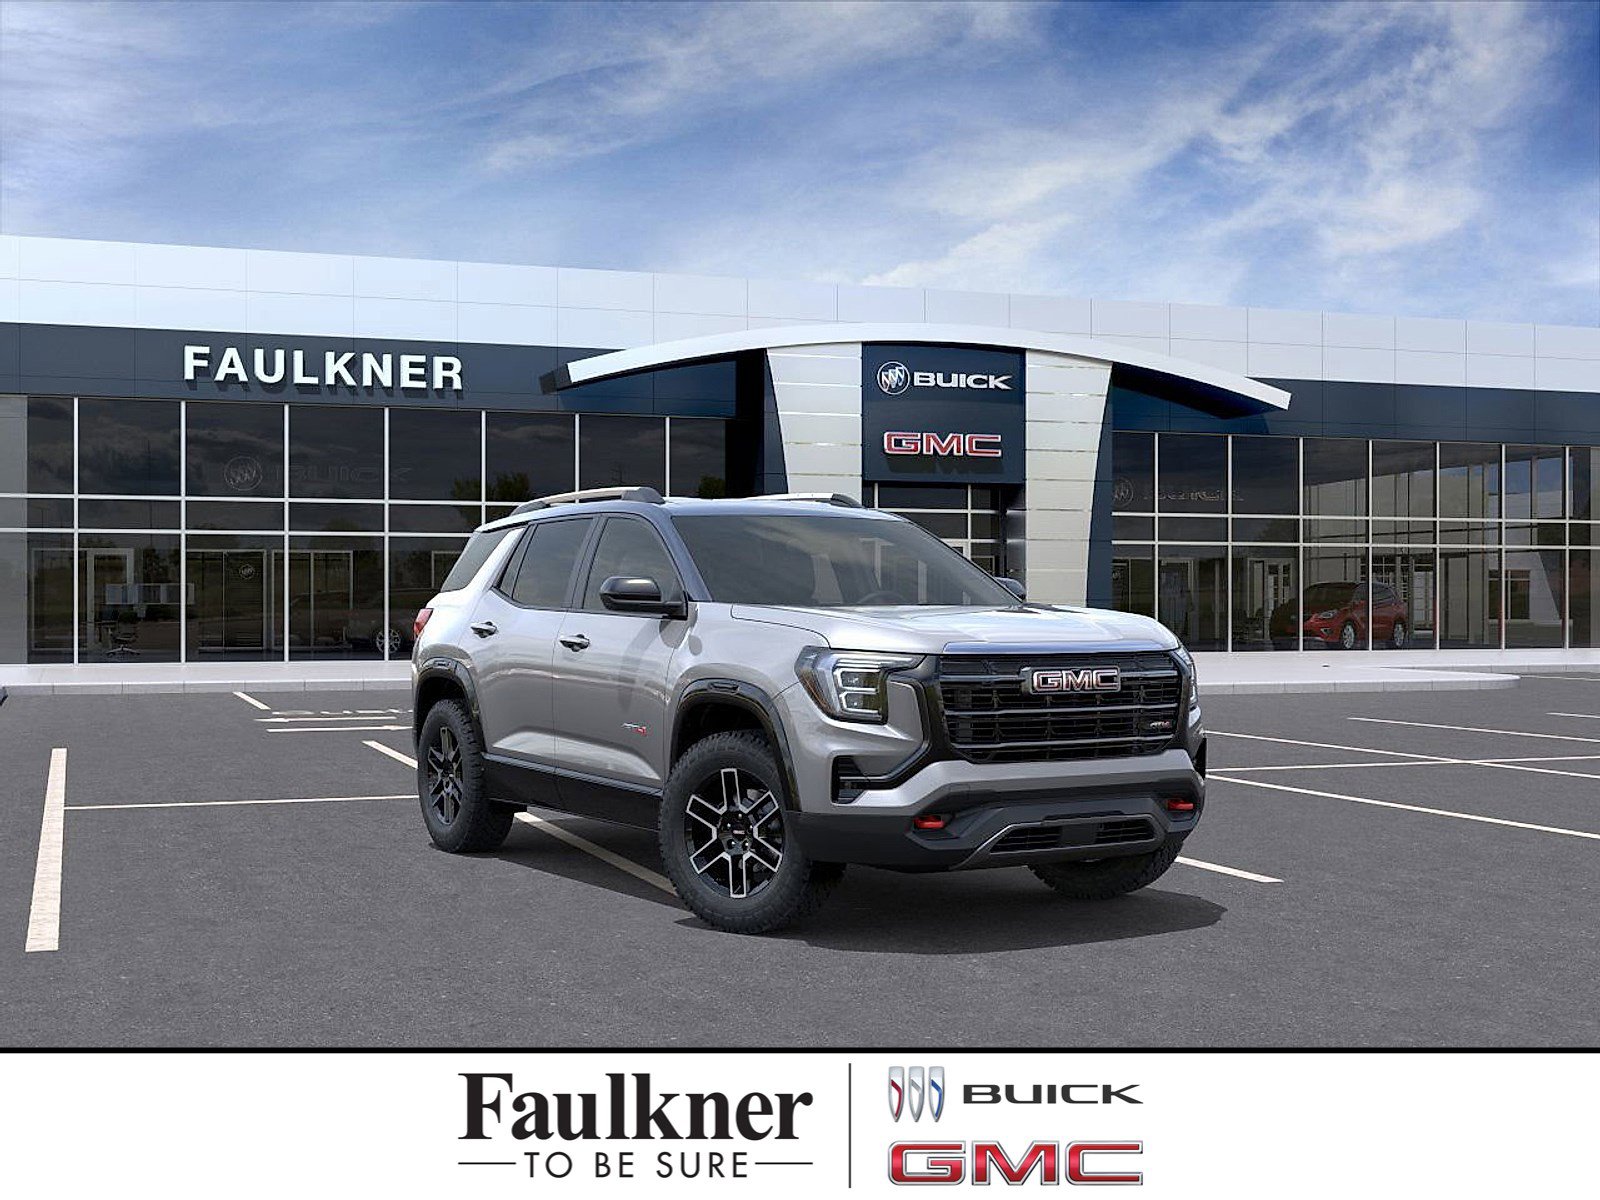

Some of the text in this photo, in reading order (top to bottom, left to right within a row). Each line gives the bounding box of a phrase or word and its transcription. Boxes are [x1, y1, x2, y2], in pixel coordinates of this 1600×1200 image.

[183, 345, 463, 390] FAULKNER
[913, 371, 1012, 390] BUICK
[883, 431, 1002, 457] GMC
[1033, 670, 1119, 691] GMC
